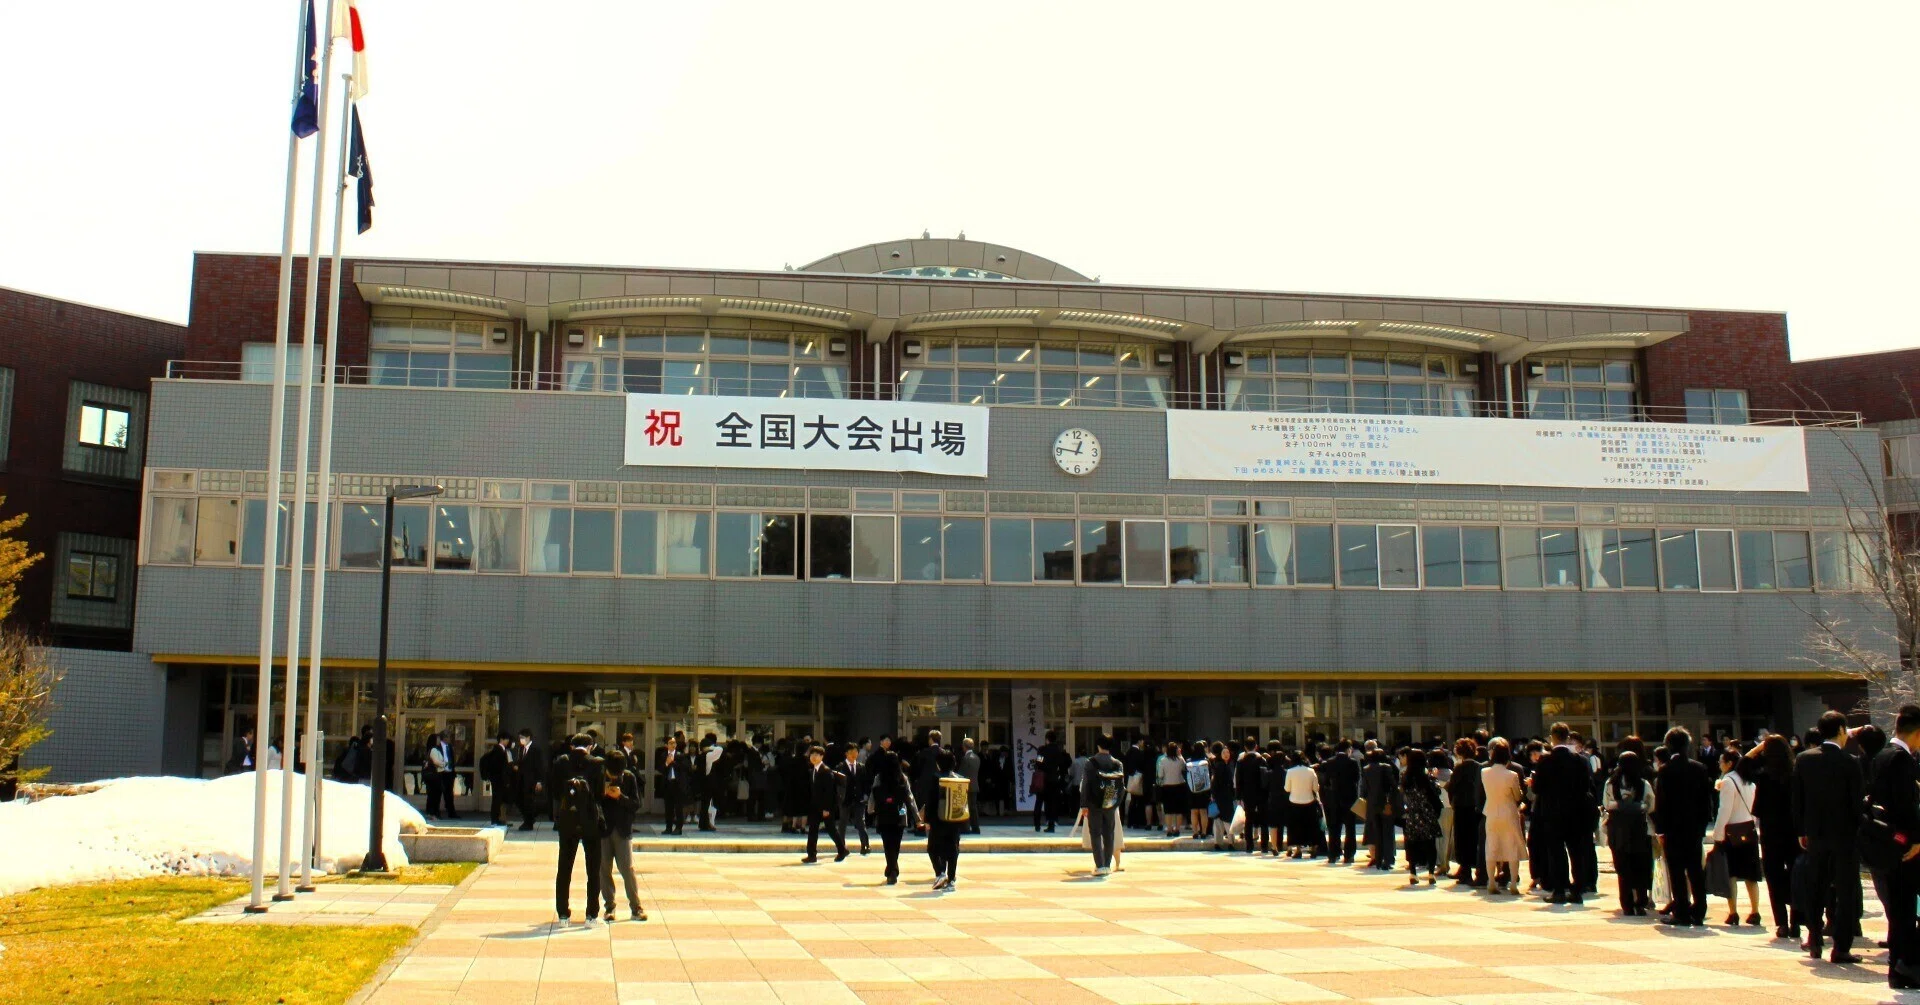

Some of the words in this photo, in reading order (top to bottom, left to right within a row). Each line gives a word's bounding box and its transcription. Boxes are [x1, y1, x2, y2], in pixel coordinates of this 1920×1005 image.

[644, 408, 683, 447] 祝
[715, 411, 967, 456] 全国大会出場
[1072, 430, 1082, 440] 12
[1056, 447, 1063, 456] 9
[1092, 448, 1098, 457] 3
[1074, 464, 1081, 474] 6
[1604, 477, 1675, 485] ラジオドキュメント部門
[1026, 694, 1037, 736] 令和六年度
